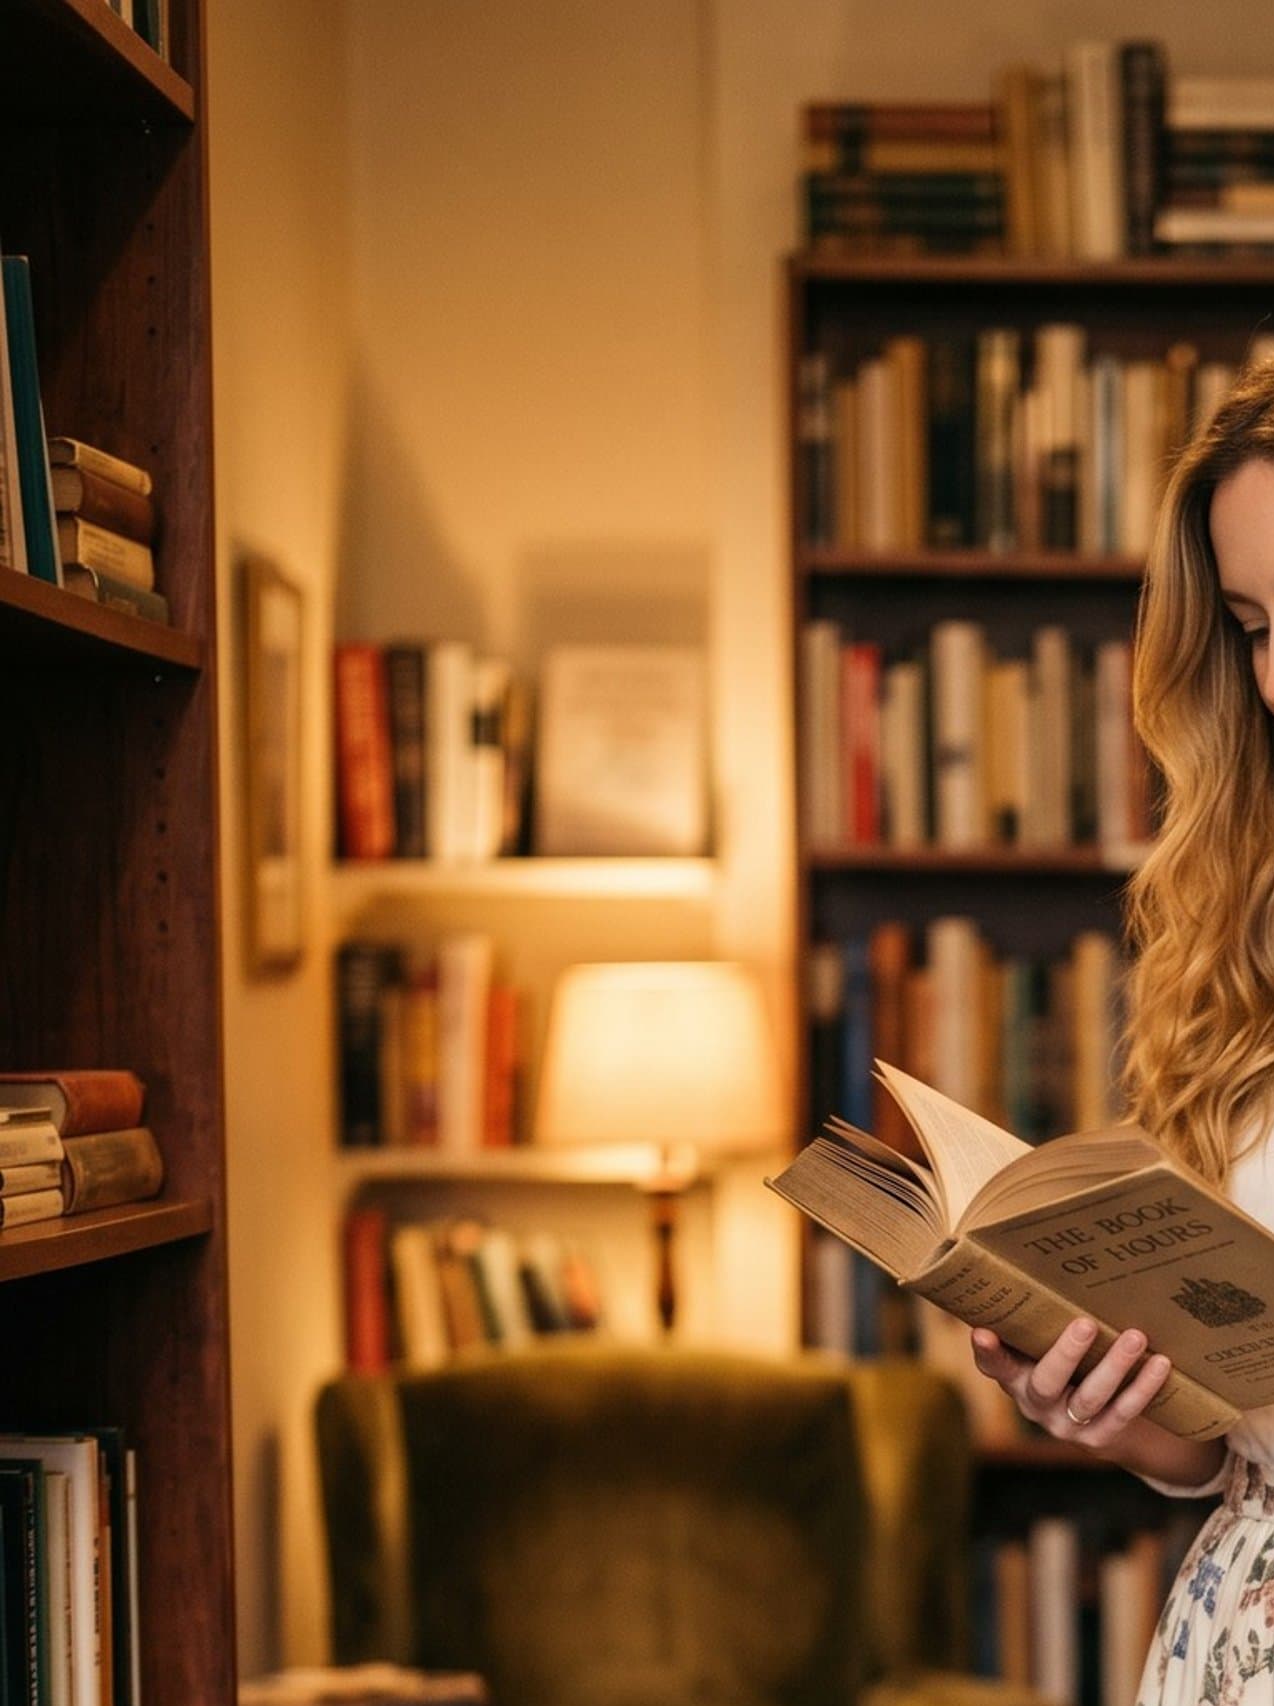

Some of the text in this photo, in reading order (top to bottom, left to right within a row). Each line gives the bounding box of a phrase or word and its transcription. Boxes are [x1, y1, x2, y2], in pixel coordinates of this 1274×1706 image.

[1024, 1197, 1190, 1256] THE BOOK
[1061, 1219, 1213, 1275] OF HOURS
